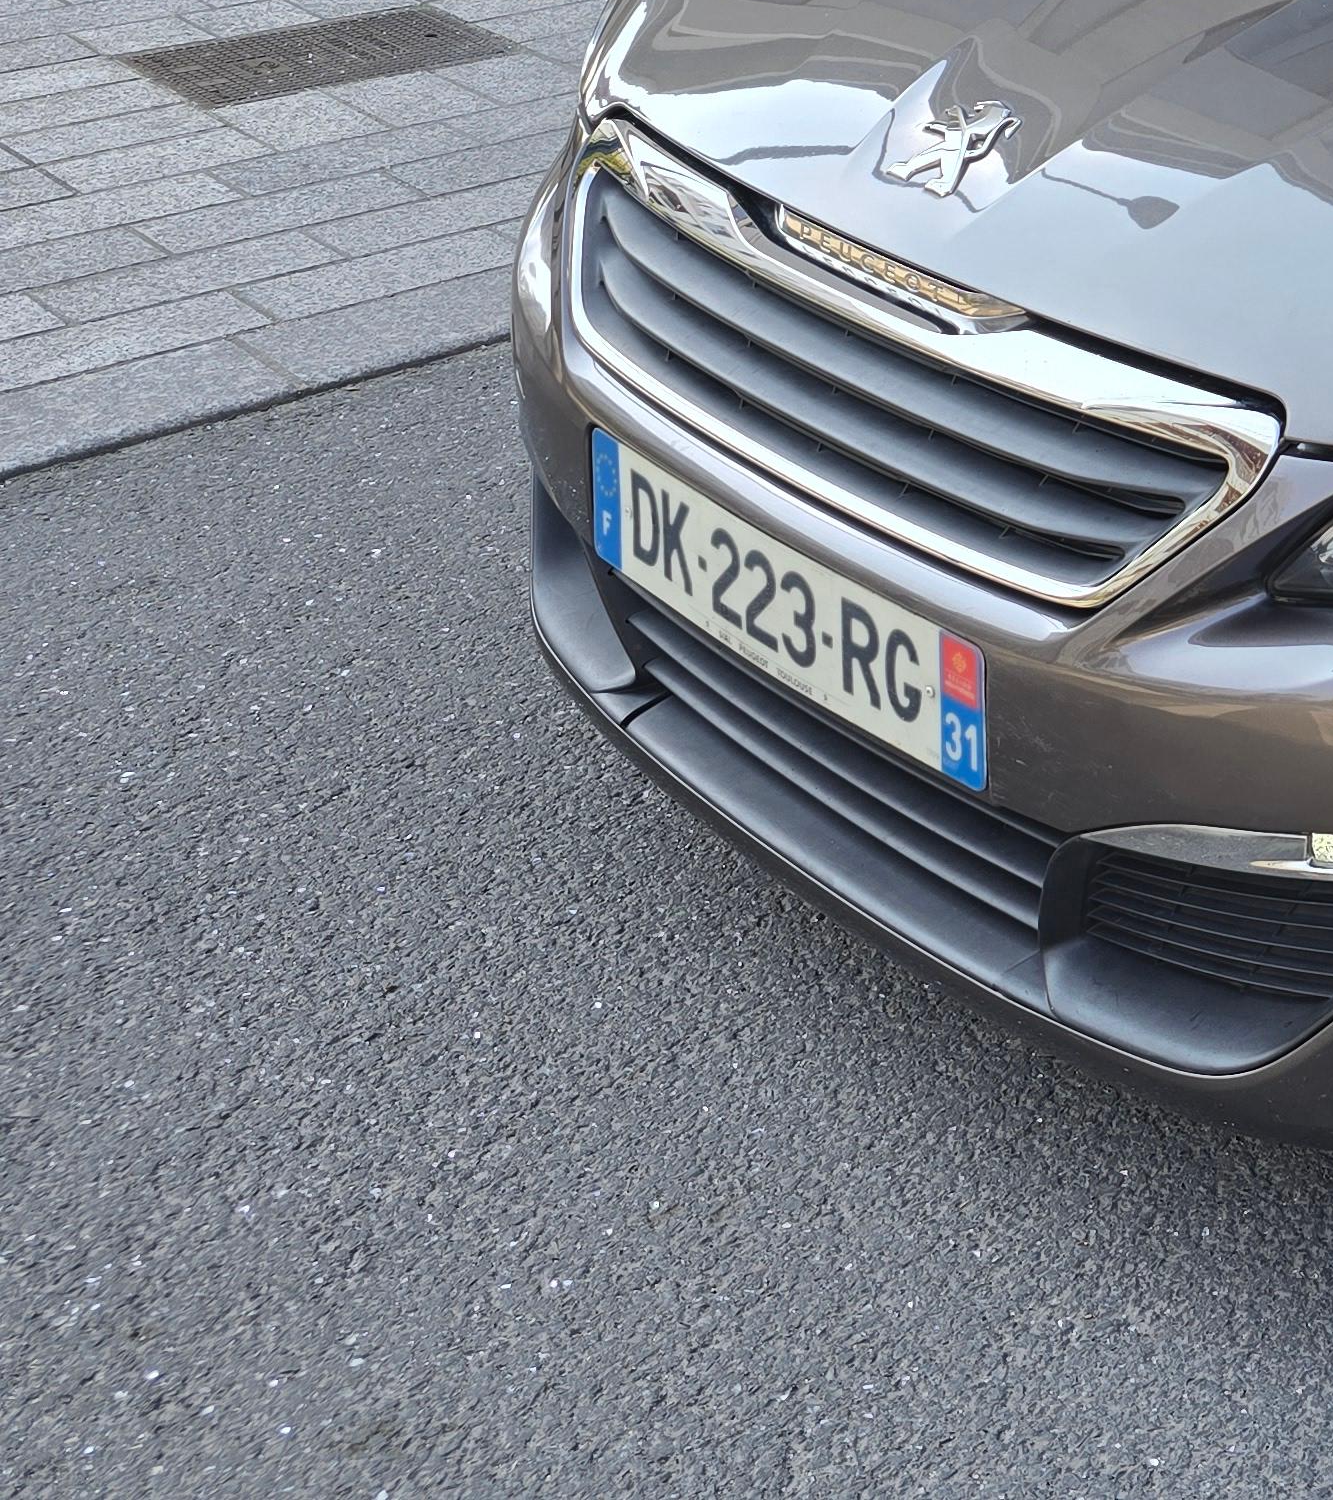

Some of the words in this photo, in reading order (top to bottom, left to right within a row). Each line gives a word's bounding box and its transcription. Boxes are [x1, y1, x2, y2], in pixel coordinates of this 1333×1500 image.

[799, 220, 944, 303] PEUGEOT
[602, 510, 612, 537] F
[630, 467, 923, 723] DK-223-RG
[775, 667, 813, 696] TOULOUSE
[944, 712, 979, 773] 31
